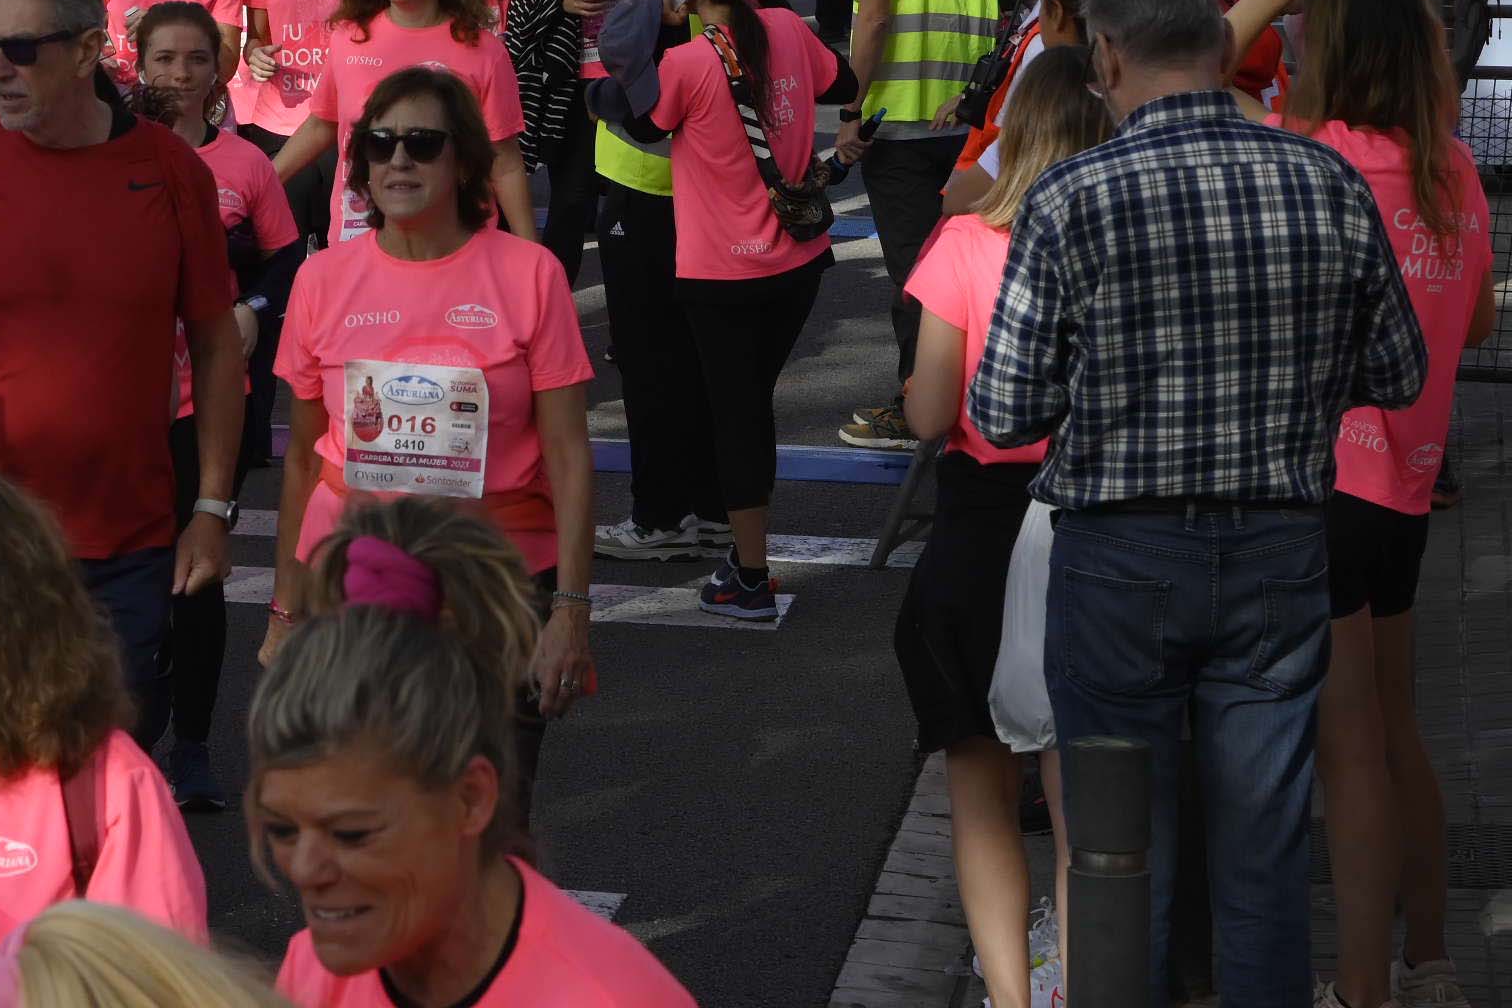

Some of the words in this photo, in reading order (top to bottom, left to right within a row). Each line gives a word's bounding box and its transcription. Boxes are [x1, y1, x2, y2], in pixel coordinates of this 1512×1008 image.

[346, 55, 383, 67] OYSHO
[345, 310, 401, 328] OYSHO
[388, 384, 439, 400] ASTURIANA
[388, 414, 437, 435] 016
[394, 438, 425, 452] 8410
[360, 453, 392, 462] CARRERA
[393, 455, 406, 464] DE
[406, 456, 417, 464] LA
[419, 457, 447, 467] MUJER
[354, 470, 394, 483] OYSHO
[426, 475, 472, 489] Santander
